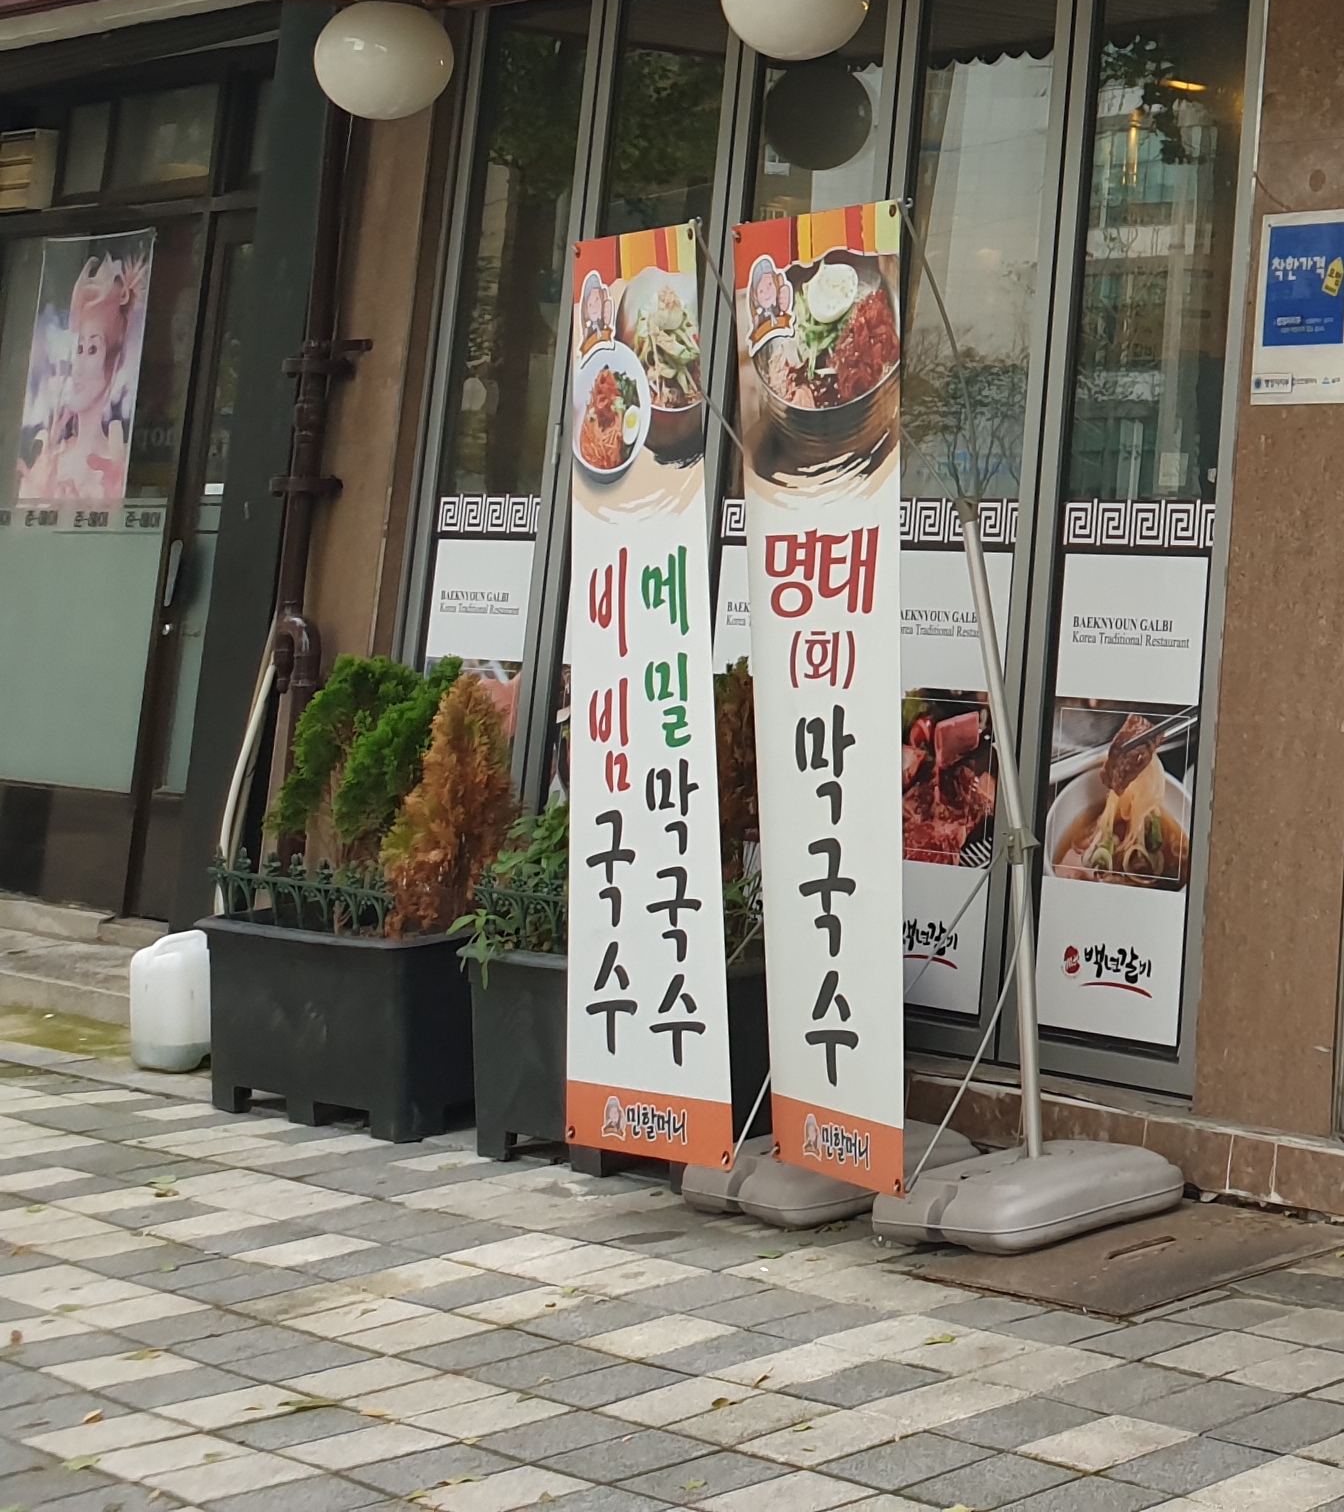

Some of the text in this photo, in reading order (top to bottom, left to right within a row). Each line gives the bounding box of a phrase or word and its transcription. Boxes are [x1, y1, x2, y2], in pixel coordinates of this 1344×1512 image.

[1271, 255, 1326, 281] 착한가격
[765, 525, 879, 619] 명태
[952, 611, 977, 623] GALB
[1073, 616, 1173, 632] BAEKNYOUN GALBI
[790, 630, 858, 690] (회)
[1072, 631, 1189, 648] Korea Traditional Restaurant
[586, 547, 638, 1055] 비빔국수
[794, 705, 859, 1087] 막국수
[1084, 944, 1152, 984] 백년갈비
[626, 1104, 687, 1145] 민할머니
[822, 1123, 871, 1169] 민할머니
